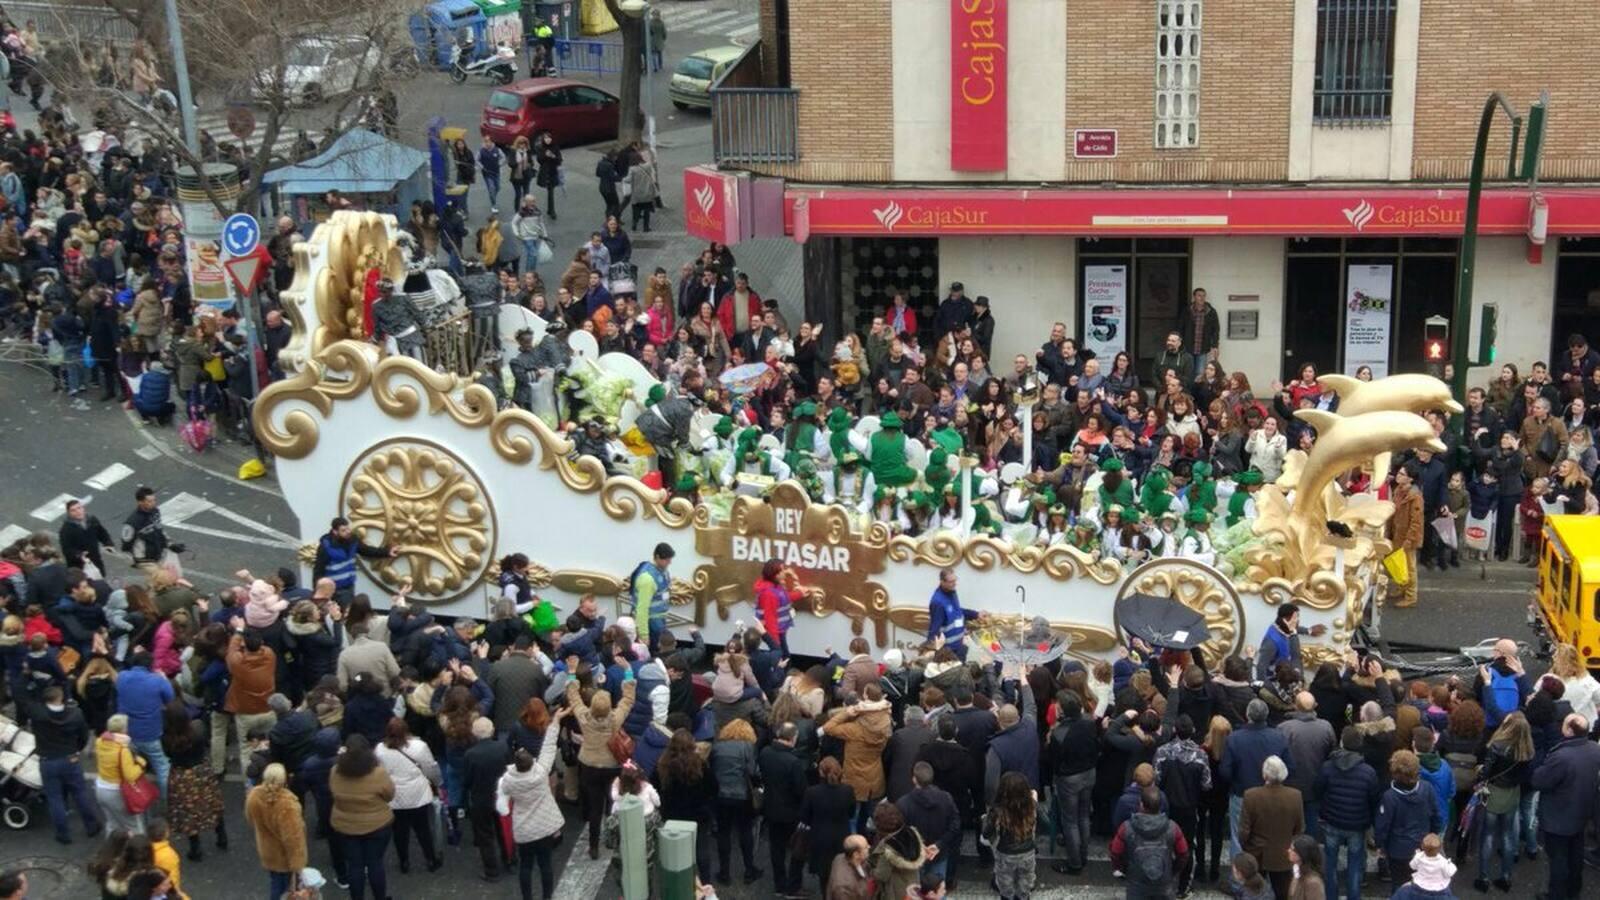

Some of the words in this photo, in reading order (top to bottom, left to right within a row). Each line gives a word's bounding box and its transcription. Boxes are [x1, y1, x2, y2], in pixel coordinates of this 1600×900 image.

[907, 205, 989, 229] CajaSur
[1378, 205, 1465, 229] CajaSur
[776, 507, 803, 535] REY
[732, 535, 850, 573] BALTASAR
